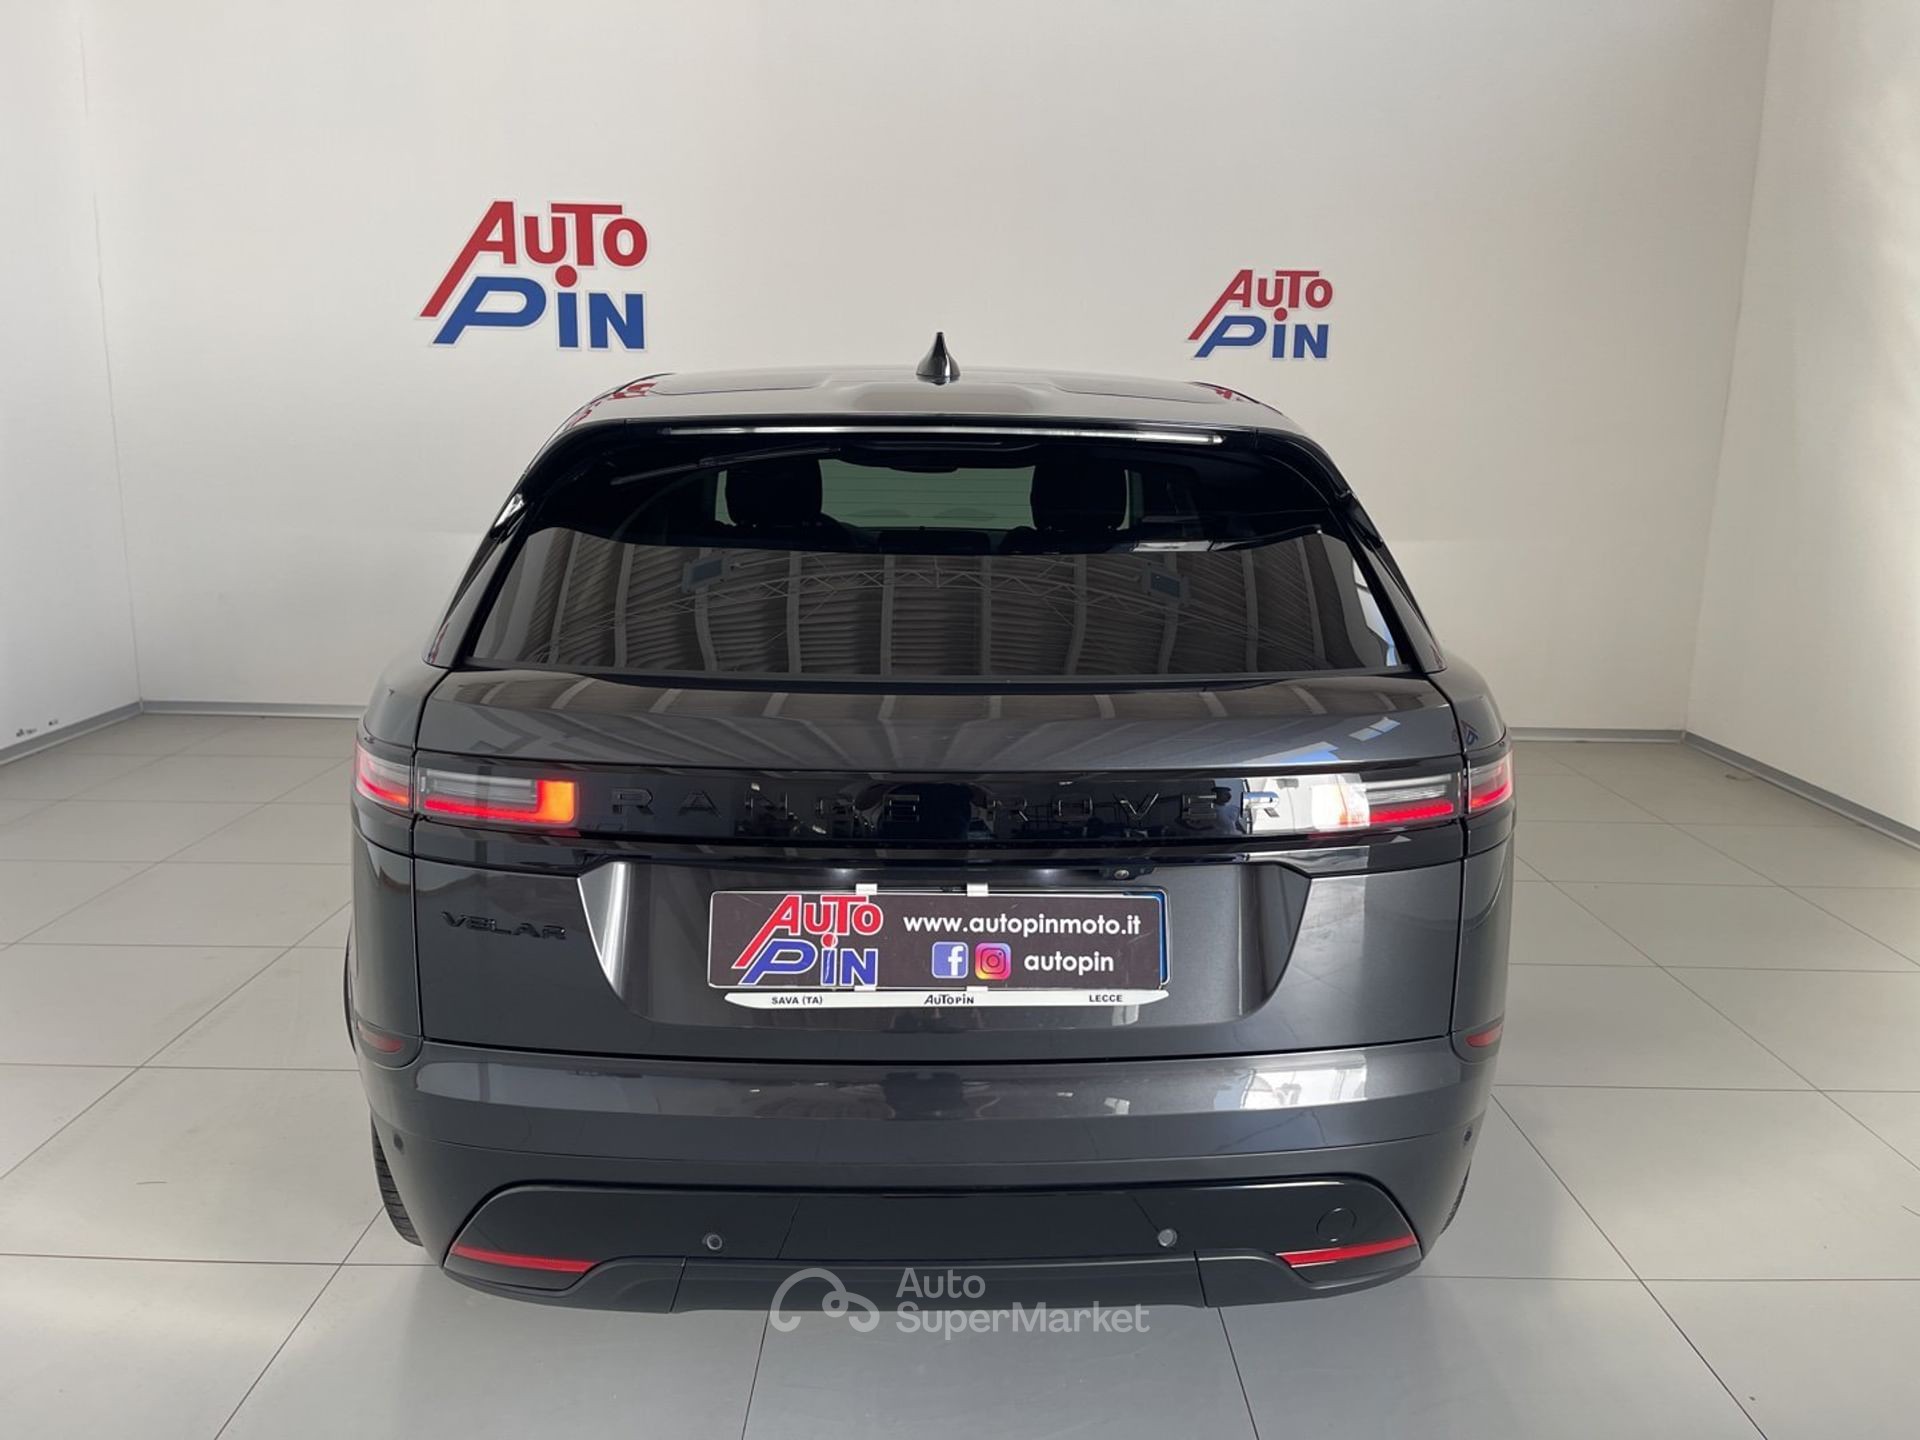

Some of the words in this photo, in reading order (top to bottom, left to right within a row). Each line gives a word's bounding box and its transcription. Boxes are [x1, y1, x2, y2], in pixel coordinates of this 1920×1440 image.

[993, 788, 1281, 822] ROVER
[440, 911, 566, 940] VELAR
[903, 912, 1142, 939] www.autopinmoto.it
[1024, 951, 1114, 976] autopin
[771, 995, 799, 1006] SAVA
[802, 995, 823, 1006] (TA)
[1089, 994, 1123, 1003] LECCE
